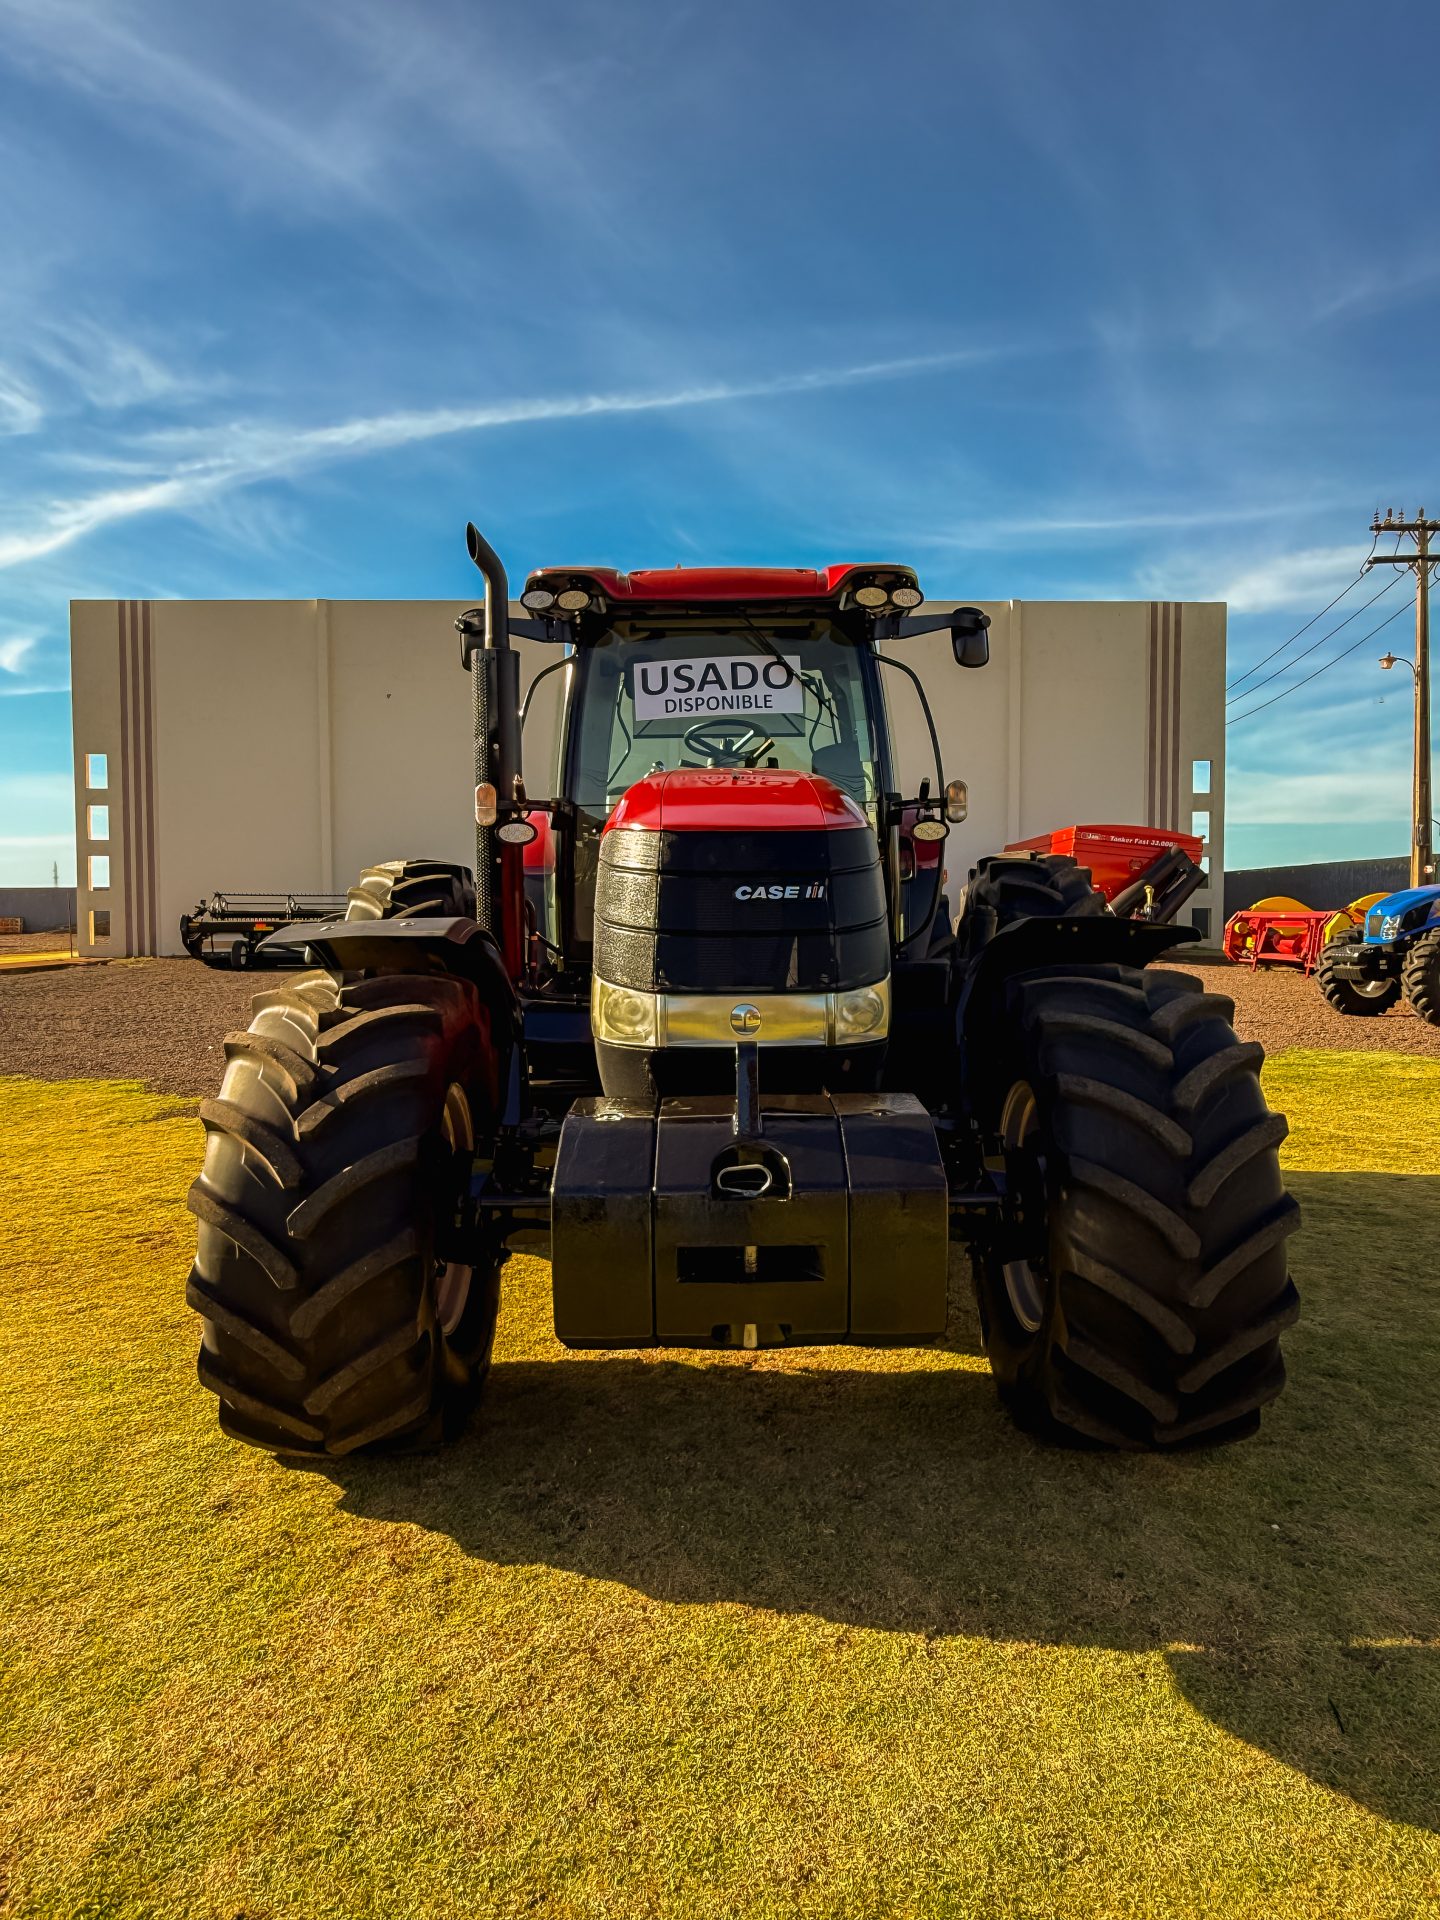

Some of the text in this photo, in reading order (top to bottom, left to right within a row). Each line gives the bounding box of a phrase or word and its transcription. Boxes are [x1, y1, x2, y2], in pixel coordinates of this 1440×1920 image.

[641, 661, 794, 695] USADO
[665, 694, 773, 713] DISPONIBLE
[1110, 835, 1133, 843] Tanker
[735, 886, 800, 900] CASE
